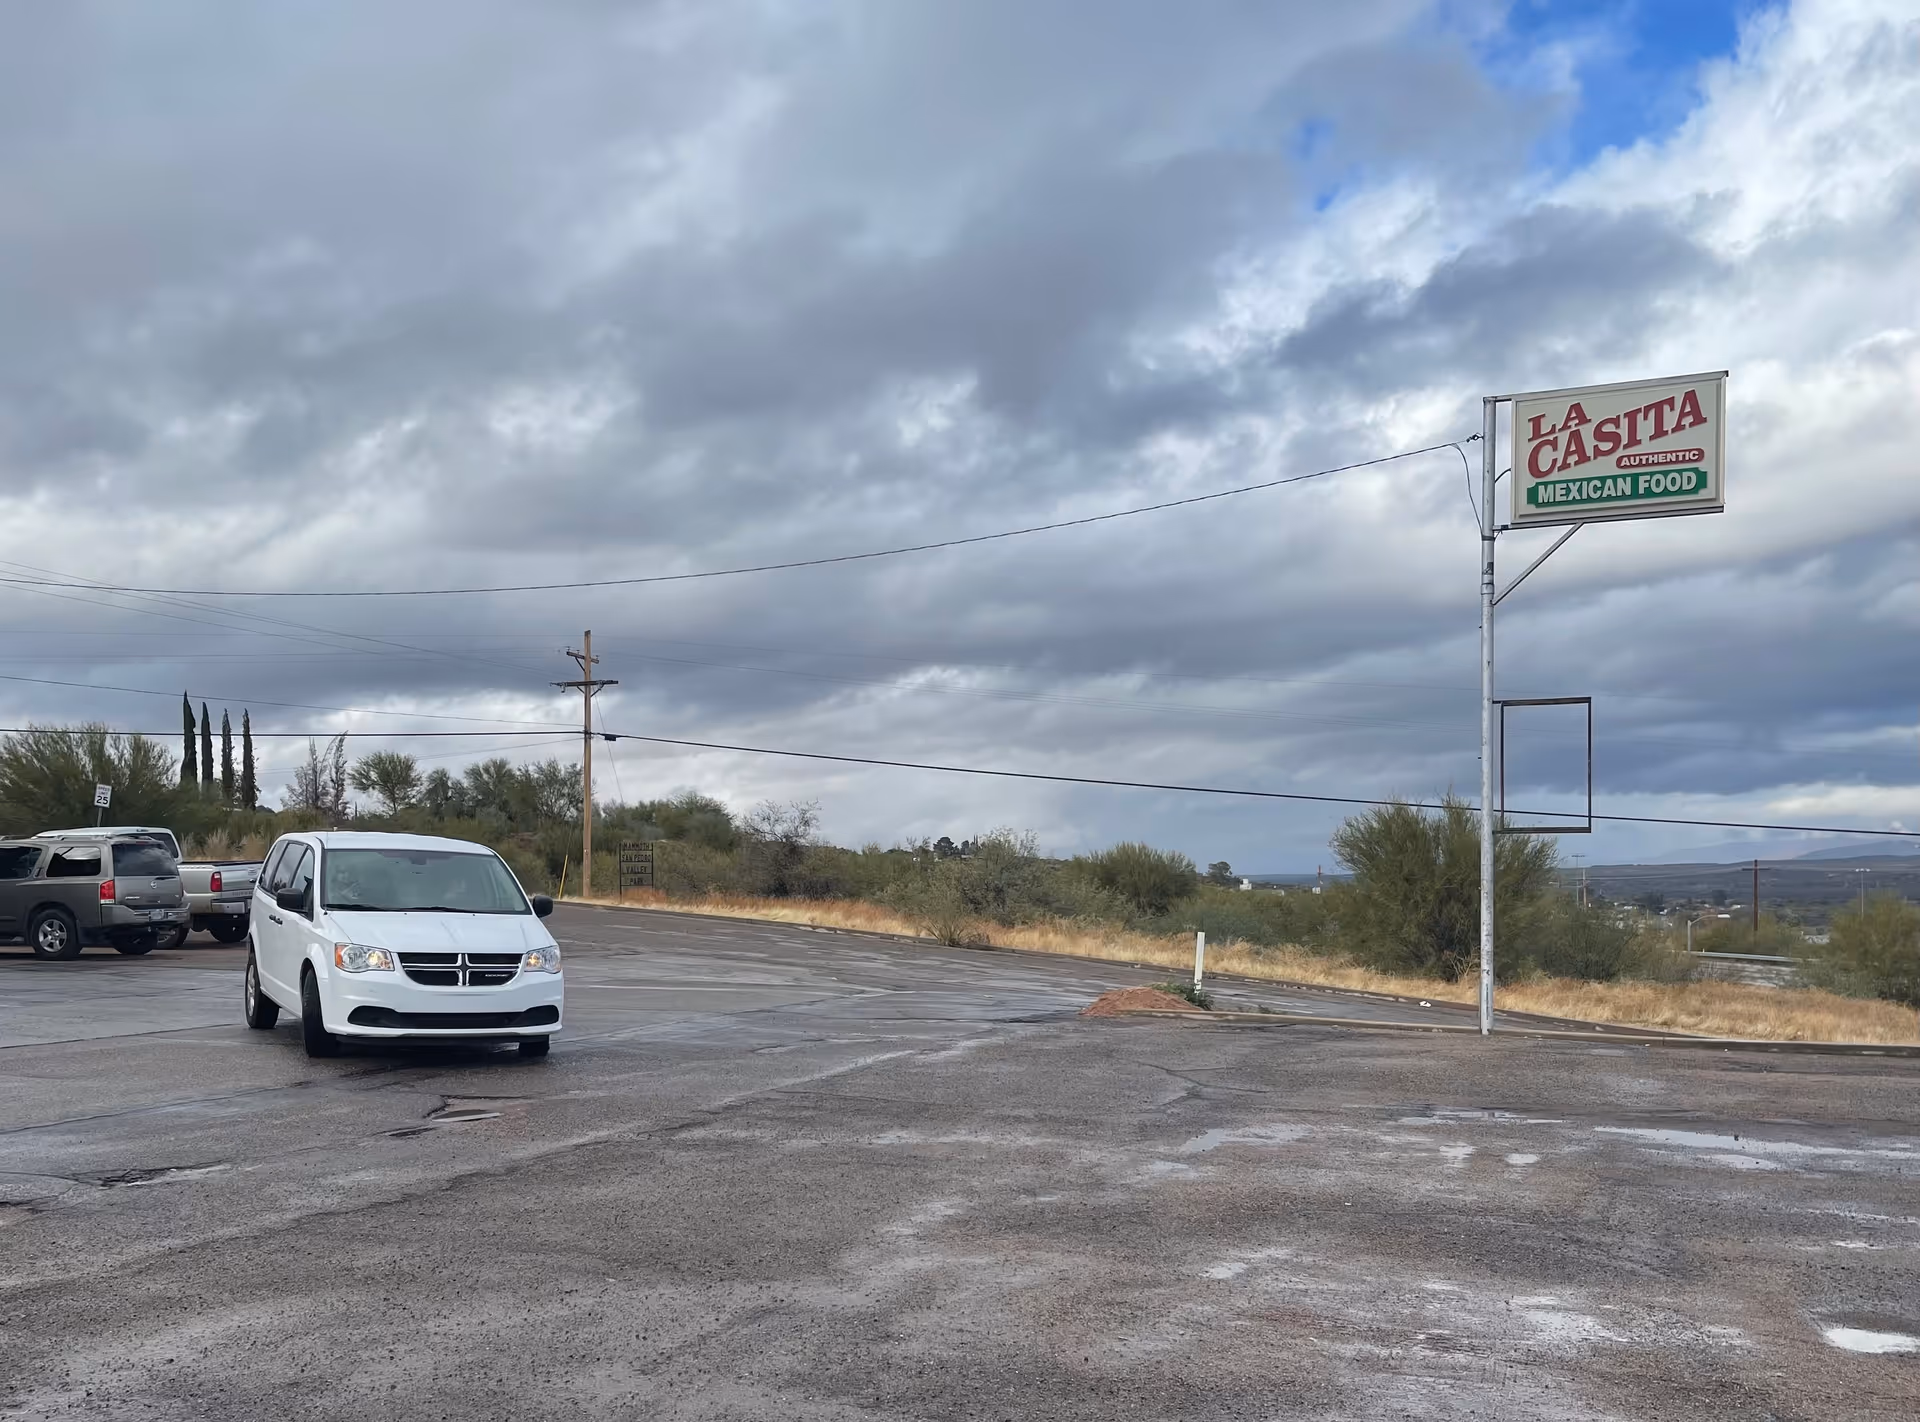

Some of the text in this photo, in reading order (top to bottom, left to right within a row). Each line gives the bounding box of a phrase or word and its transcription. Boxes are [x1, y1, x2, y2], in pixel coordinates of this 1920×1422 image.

[1527, 402, 1592, 442] LA
[1528, 389, 1707, 478] CASITA
[1620, 450, 1699, 467] AUTHENTIC
[1537, 471, 1697, 504] MEXICAN FOOD
[96, 796, 108, 805] 25
[623, 842, 650, 850] MAMMOTH
[621, 854, 651, 862] SAN PEDRO
[626, 866, 648, 874] VALLEY
[629, 877, 644, 885] PARK
